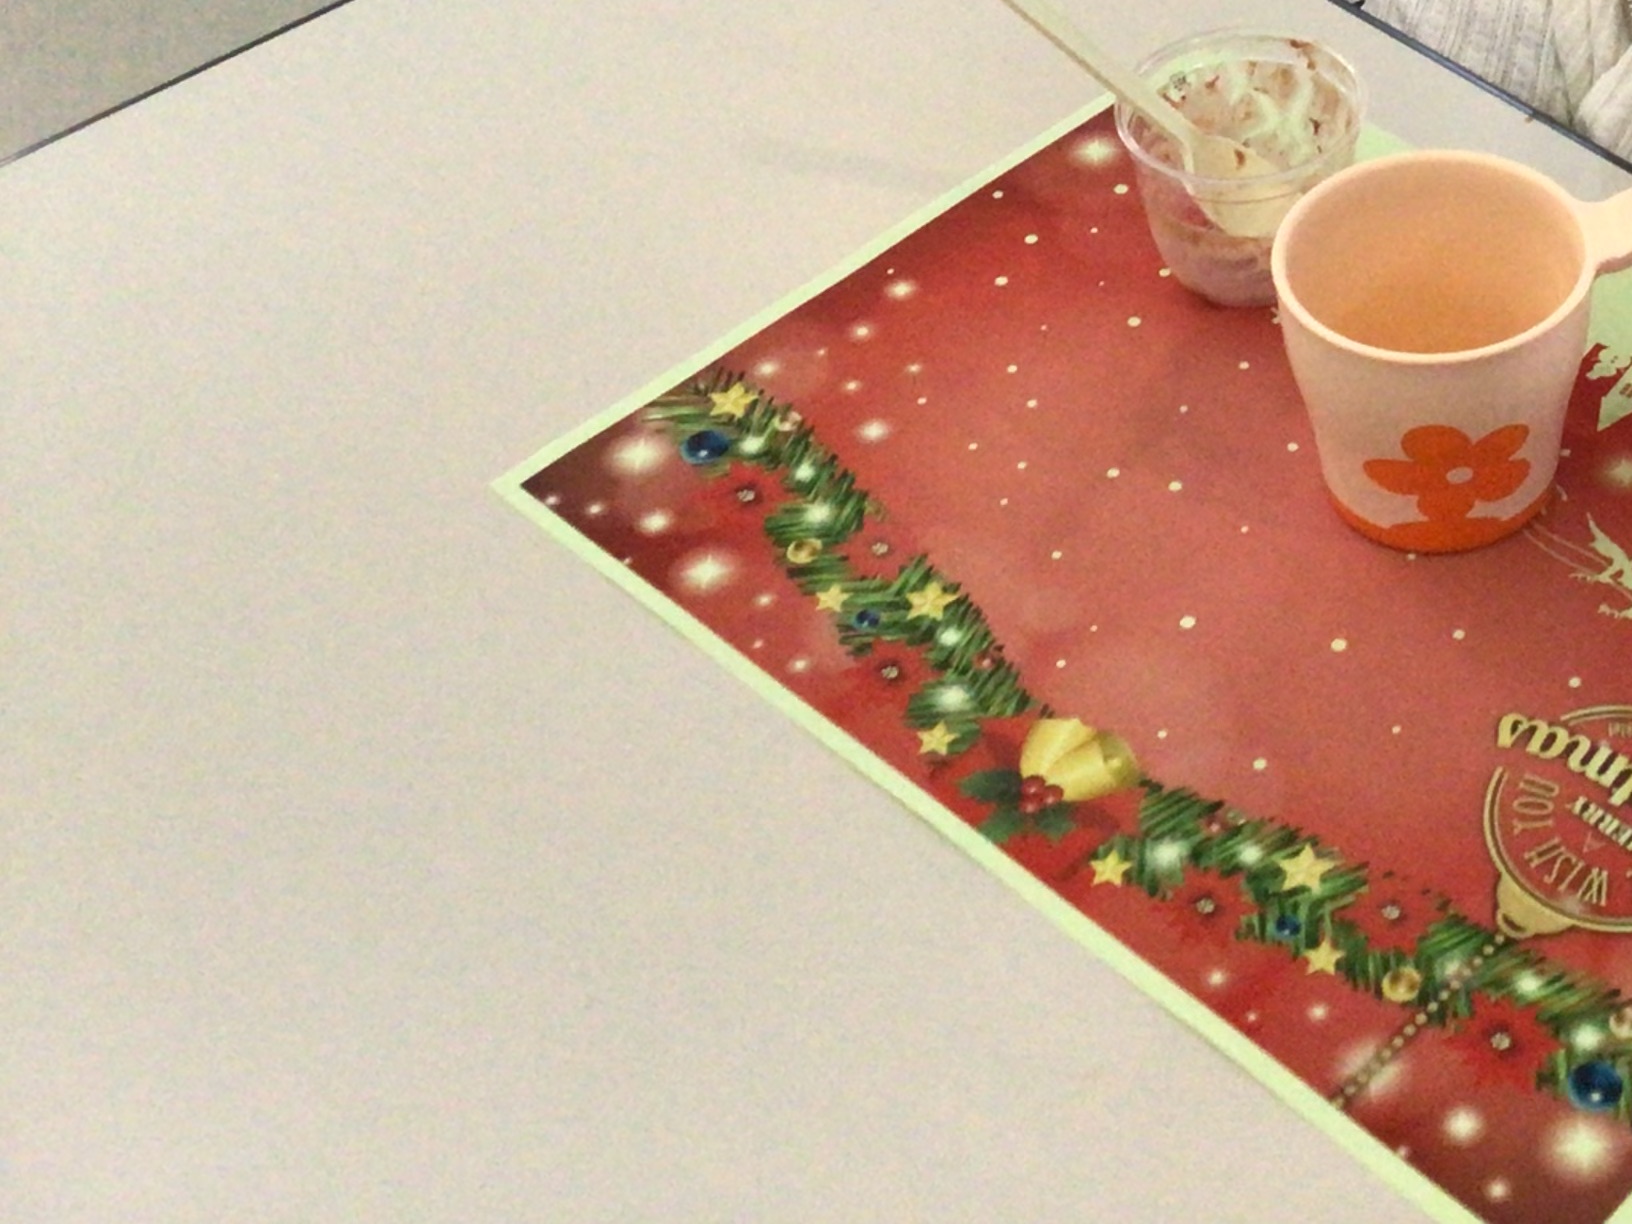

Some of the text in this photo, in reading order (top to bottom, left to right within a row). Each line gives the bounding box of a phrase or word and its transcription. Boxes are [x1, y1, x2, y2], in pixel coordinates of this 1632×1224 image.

[1512, 775, 1559, 835] YOU
[1524, 838, 1608, 906] WISH
[1583, 832, 1604, 853] A
